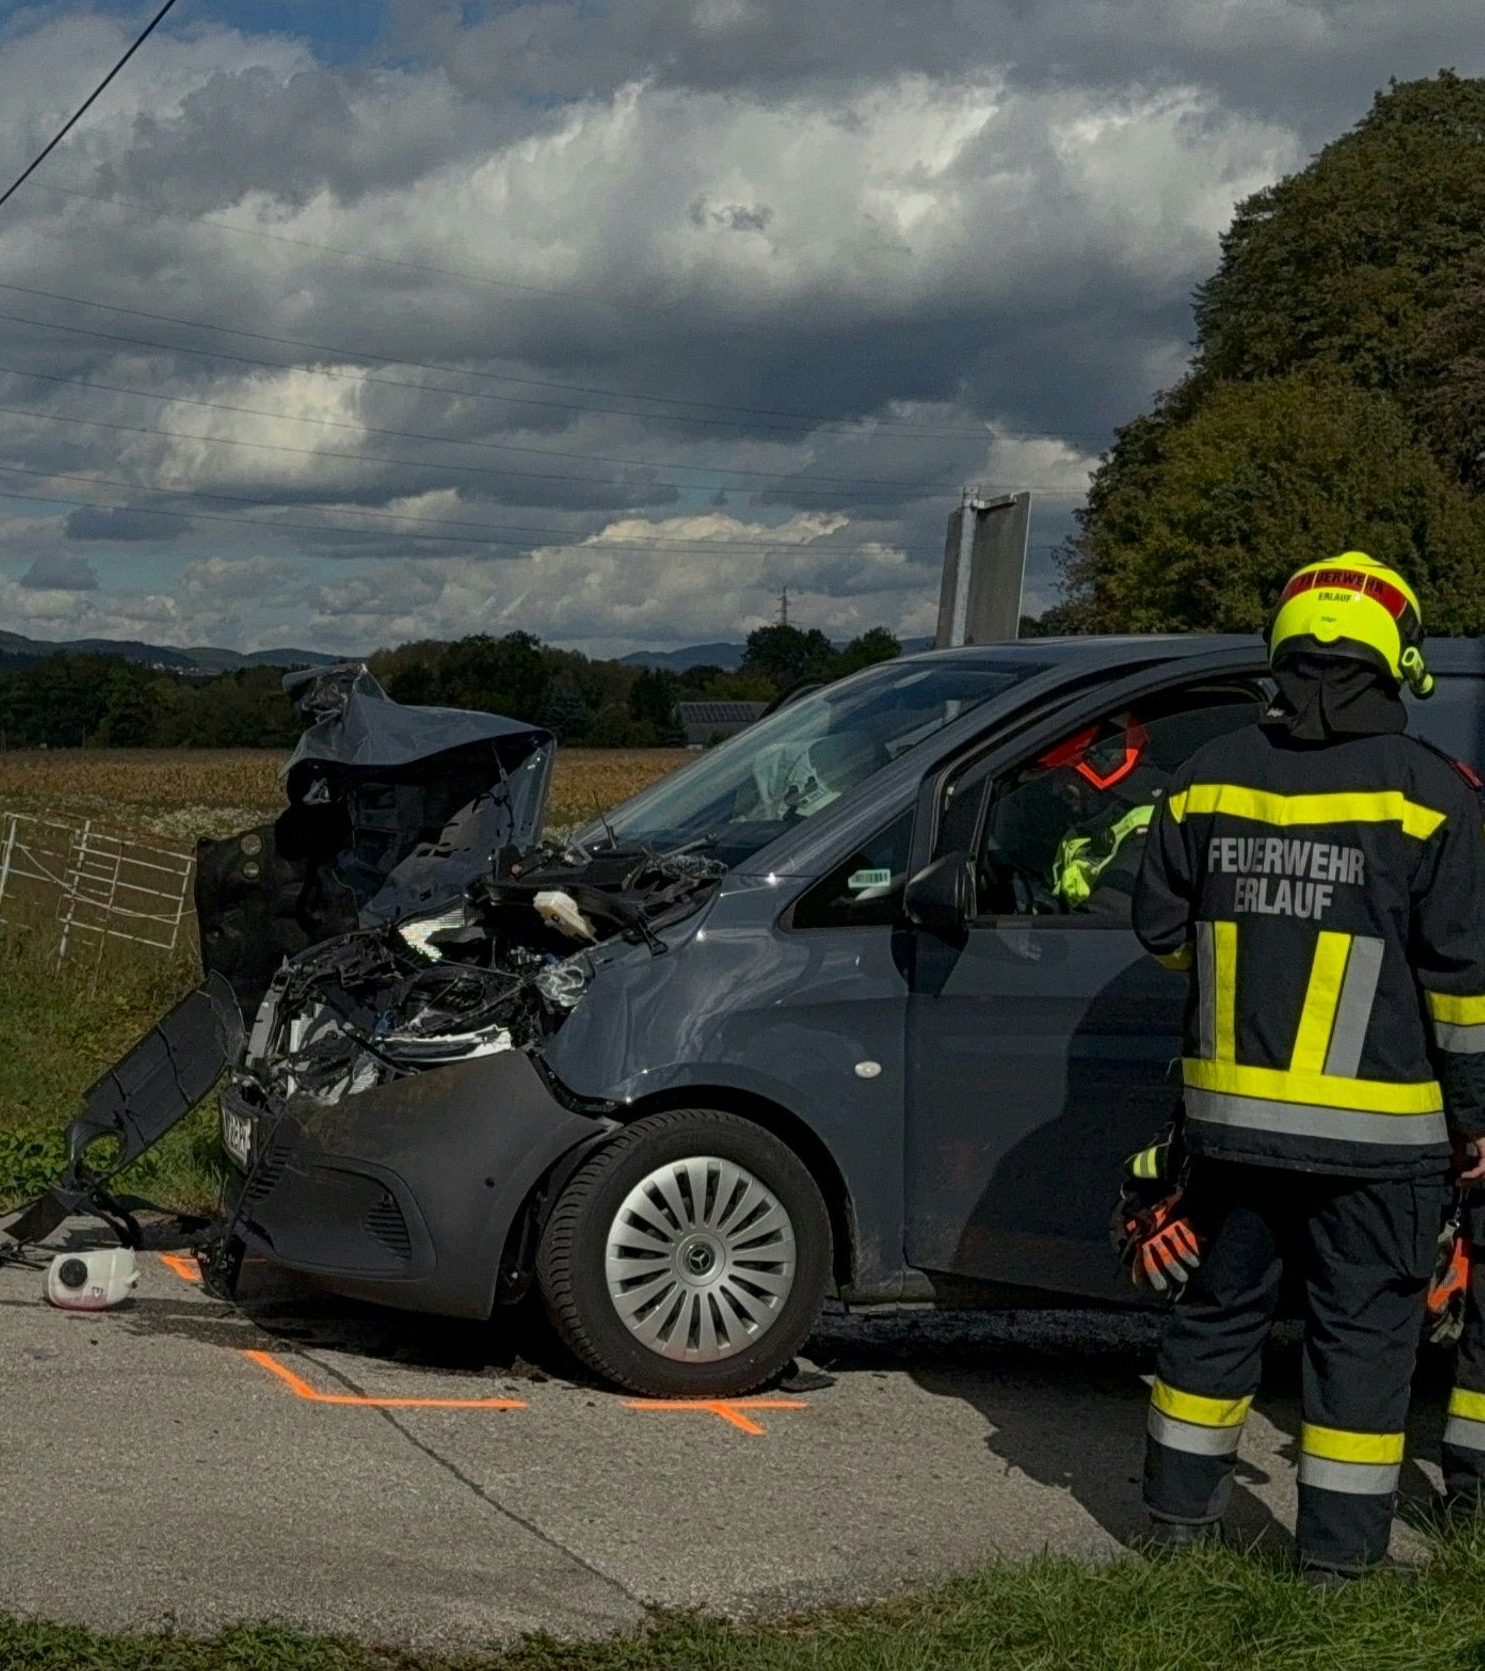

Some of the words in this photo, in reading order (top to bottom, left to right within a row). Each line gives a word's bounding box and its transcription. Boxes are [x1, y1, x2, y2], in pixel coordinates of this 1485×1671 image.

[1318, 592, 1352, 602] ERLAUF
[1208, 837, 1365, 886] FEUERWEHR
[1234, 877, 1333, 920] ERLAUF
